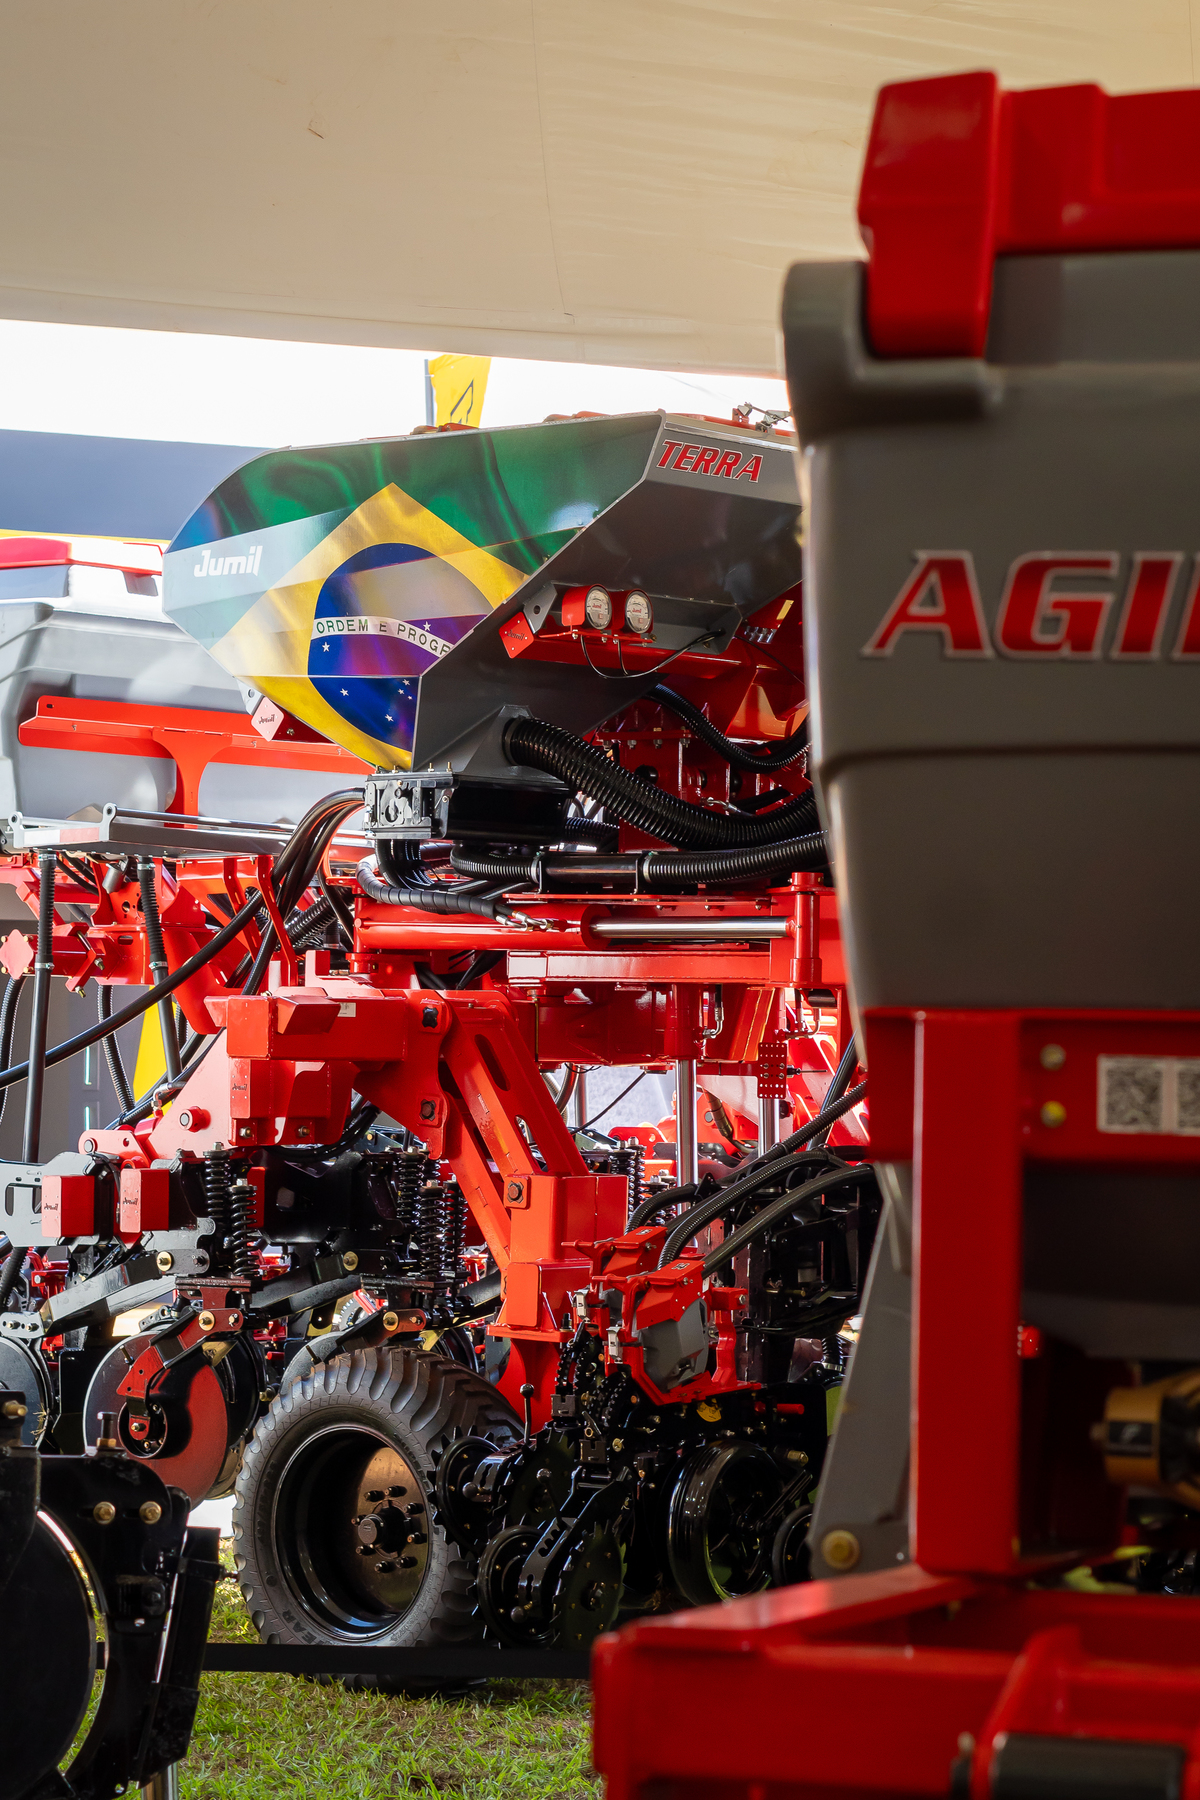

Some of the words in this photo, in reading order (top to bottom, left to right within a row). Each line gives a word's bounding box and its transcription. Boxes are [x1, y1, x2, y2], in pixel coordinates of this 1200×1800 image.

[656, 439, 764, 483] TERRA
[193, 545, 263, 578] Jumil
[316, 618, 369, 634] ORDEM
[379, 620, 388, 632] E
